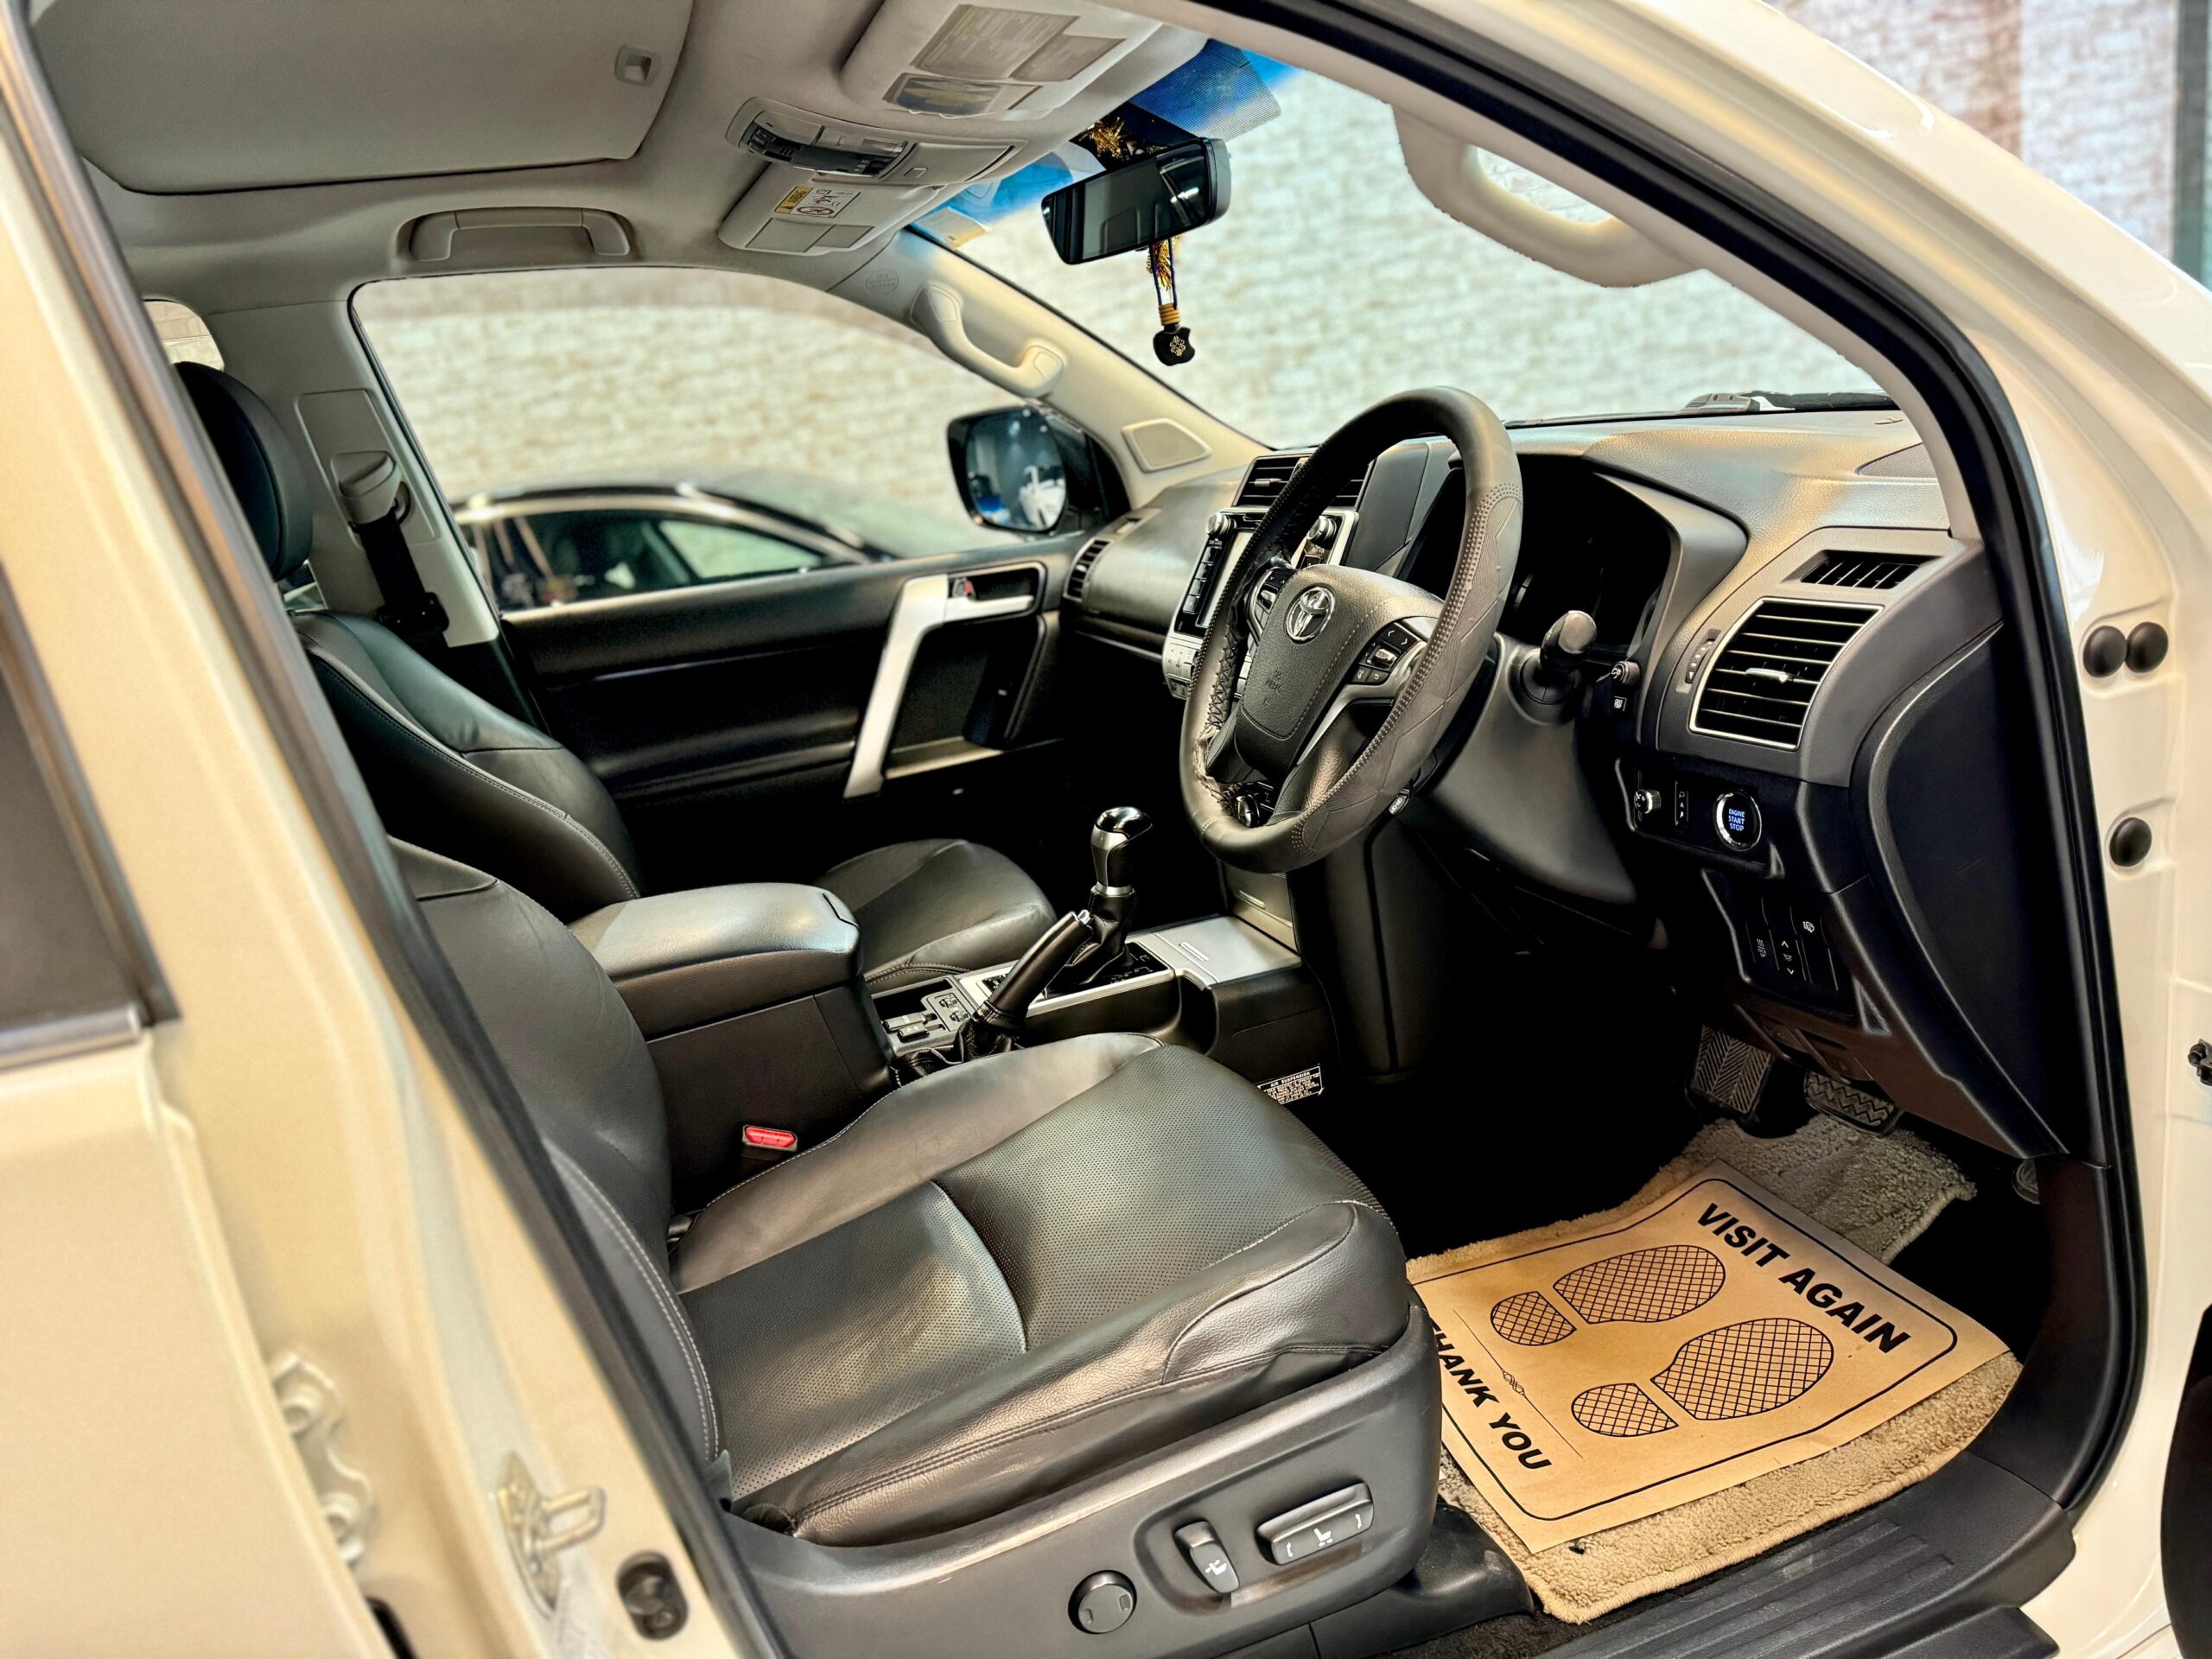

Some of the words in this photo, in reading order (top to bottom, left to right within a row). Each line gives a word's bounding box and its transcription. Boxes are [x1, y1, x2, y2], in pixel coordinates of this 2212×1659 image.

[1728, 808, 1745, 817] ENGINE
[1728, 816, 1745, 824] START
[1729, 823, 1745, 831] STOP
[1281, 1071, 1311, 1084] SUSPENSION
[1697, 1203, 1790, 1268] VISIT
[1778, 1268, 1911, 1353] AGAIN
[1489, 1412, 1553, 1469] YOU
